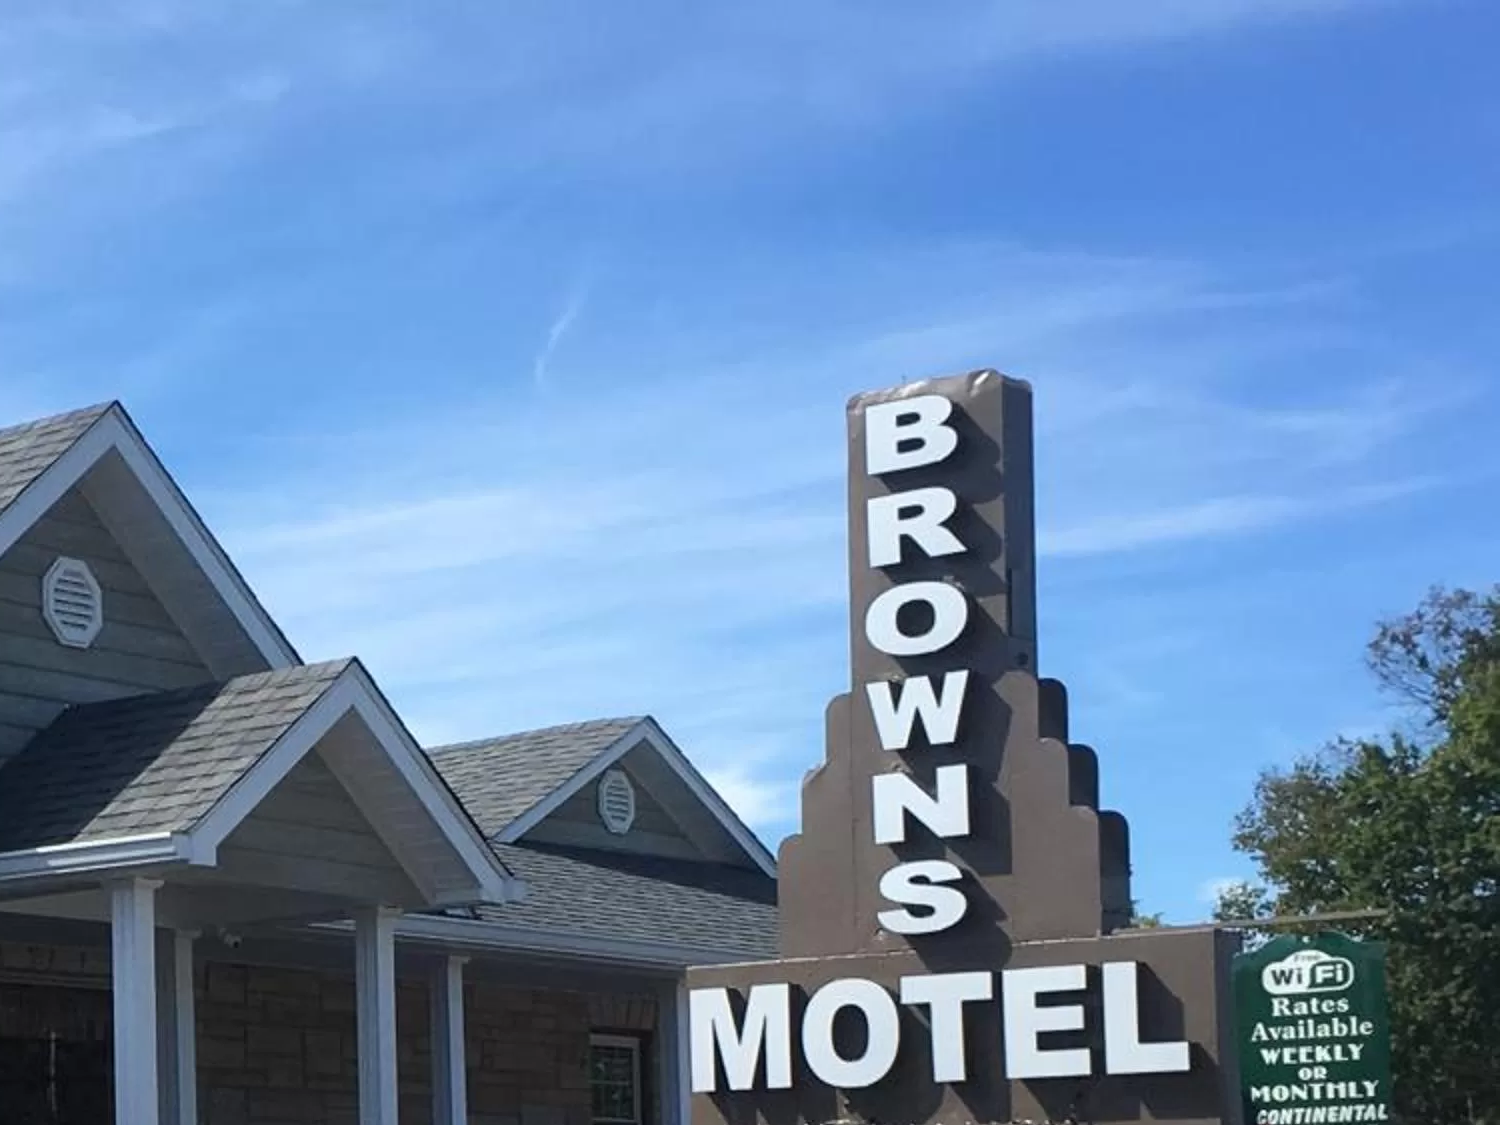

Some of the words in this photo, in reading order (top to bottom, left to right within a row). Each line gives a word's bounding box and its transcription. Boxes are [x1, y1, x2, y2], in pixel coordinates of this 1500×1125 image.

[866, 395, 969, 935] BROWNS
[1271, 997, 1349, 1017] Rates
[689, 961, 1191, 1093] MOTEL
[1251, 1016, 1374, 1042] Available
[1260, 1043, 1364, 1065] WEEKLY
[1298, 1066, 1327, 1080] OR
[1251, 1079, 1379, 1102] MONTHLY
[1257, 1103, 1388, 1125] CONTINENTAL
